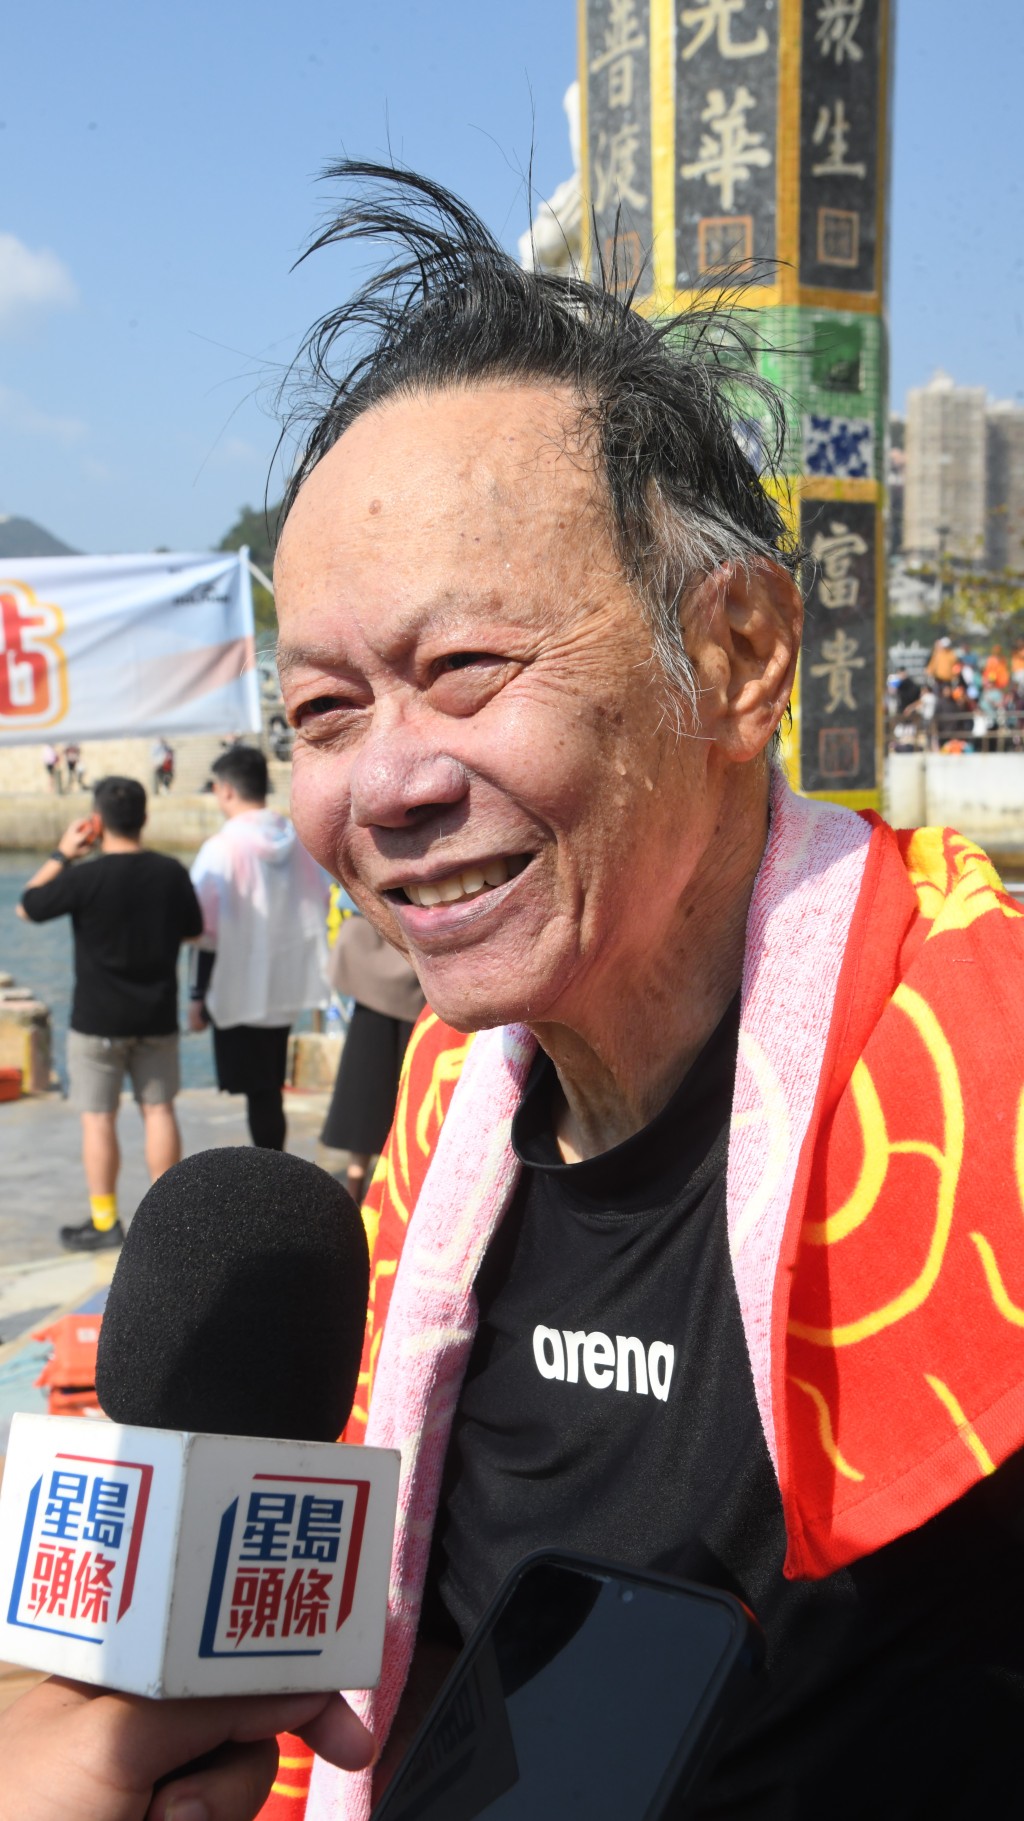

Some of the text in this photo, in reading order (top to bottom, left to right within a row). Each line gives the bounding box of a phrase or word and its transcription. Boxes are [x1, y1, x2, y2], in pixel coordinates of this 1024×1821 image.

[680, 0, 772, 210] 光華
[809, 521, 868, 714] 富貴
[532, 1324, 675, 1403] arena
[41, 1470, 129, 1549] 星島
[238, 1492, 344, 1563] 星島
[27, 1543, 118, 1624] 頭條
[225, 1567, 333, 1649] 頭條
